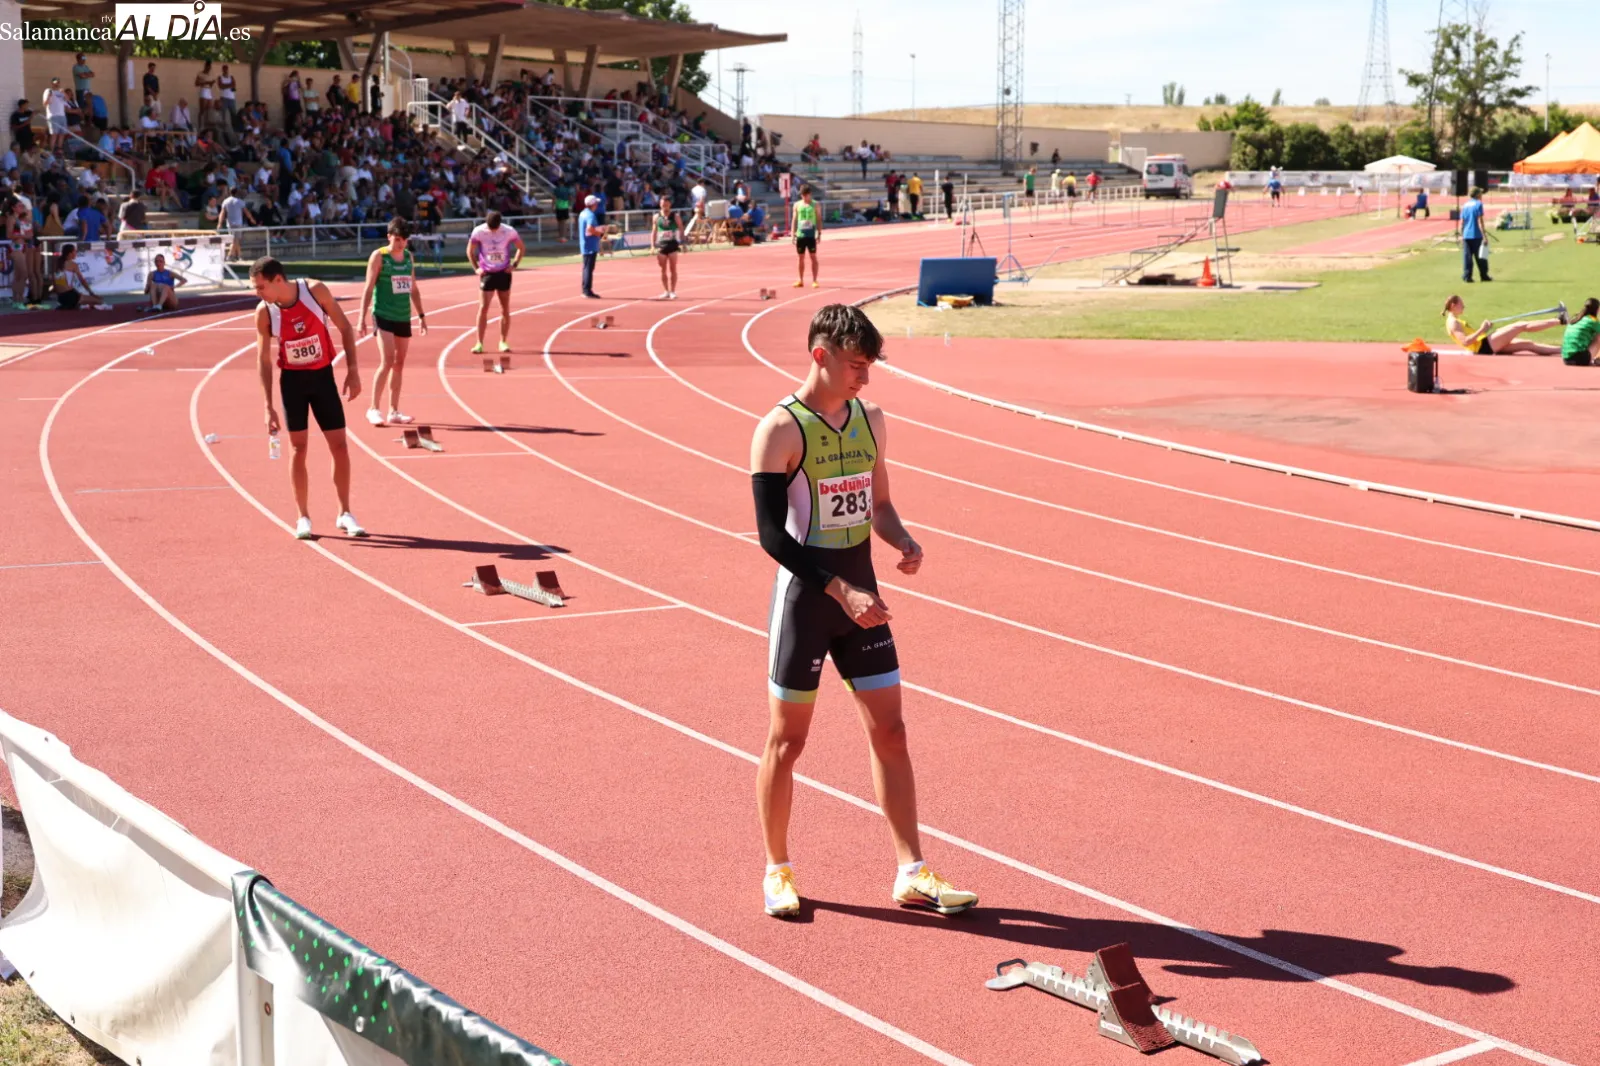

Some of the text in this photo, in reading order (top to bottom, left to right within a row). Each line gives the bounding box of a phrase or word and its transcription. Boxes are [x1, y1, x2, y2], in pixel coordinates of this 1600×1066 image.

[292, 344, 316, 359] 380
[815, 455, 827, 465] LA
[828, 449, 863, 463] GRANJA
[819, 476, 871, 496] bedunia
[831, 490, 867, 517] 283
